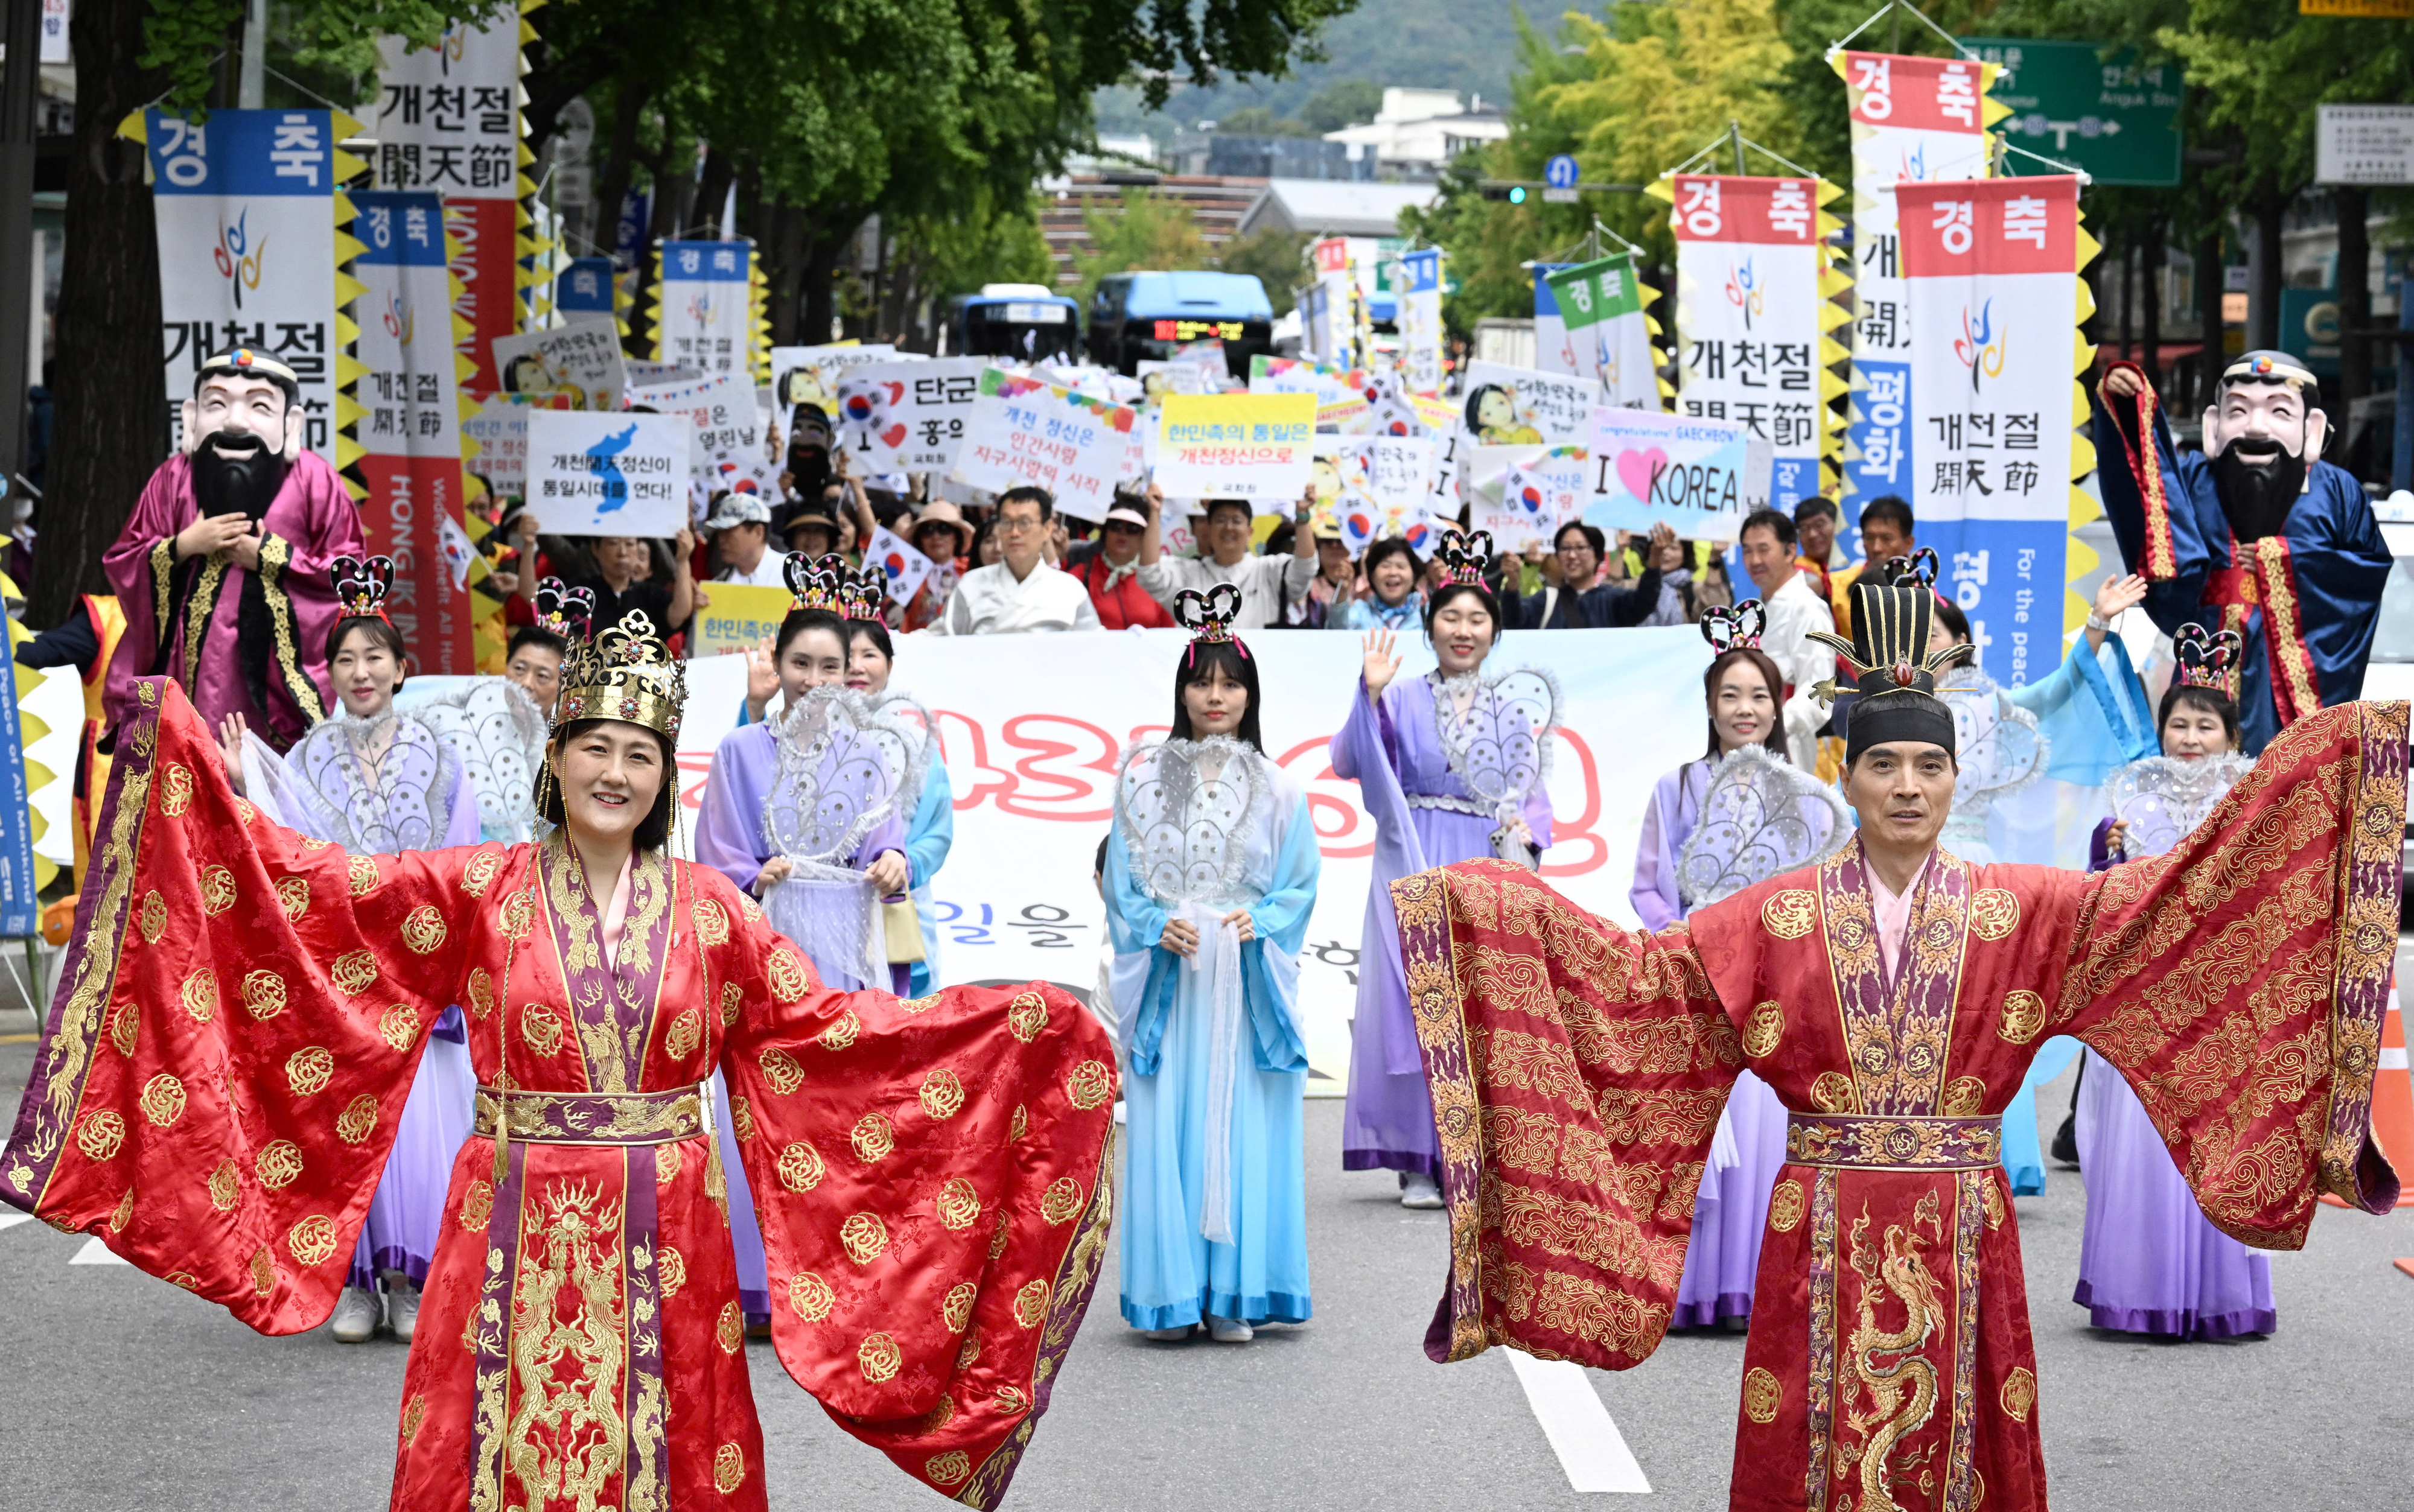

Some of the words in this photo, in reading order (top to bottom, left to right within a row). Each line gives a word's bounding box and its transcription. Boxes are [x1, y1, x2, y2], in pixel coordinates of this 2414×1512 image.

[382, 83, 512, 134] 개천절
[382, 142, 512, 188] 開天節
[1690, 340, 1811, 391] 개천절
[915, 376, 976, 405] 단군
[1515, 378, 1587, 402] 대한민국의
[1004, 405, 1037, 430] 개천
[1046, 415, 1095, 448] 정신은
[1168, 424, 1246, 442] 한민족의
[1252, 424, 1310, 442] 통일은
[1859, 370, 1906, 484] 평화
[1929, 413, 2039, 449] 개천절
[551, 454, 671, 474] 개천開天정신이
[1009, 431, 1078, 466] 인간사랑
[1179, 447, 1293, 466] 개천정신으로
[1339, 446, 1417, 462] 대민국의
[972, 444, 1059, 482] 지구사랑의
[1066, 472, 1101, 496] 시작
[1595, 454, 1610, 494] I
[1648, 459, 1737, 513] KOREA
[1931, 460, 2039, 497] 開天節
[543, 480, 626, 500] 통일시대를
[390, 475, 416, 571] HONG
[2016, 548, 2036, 581] For
[2014, 590, 2034, 624] the
[8, 744, 19, 765] of
[12, 772, 24, 802] All
[16, 809, 33, 904] Mankind
[935, 903, 1088, 950] 일을
